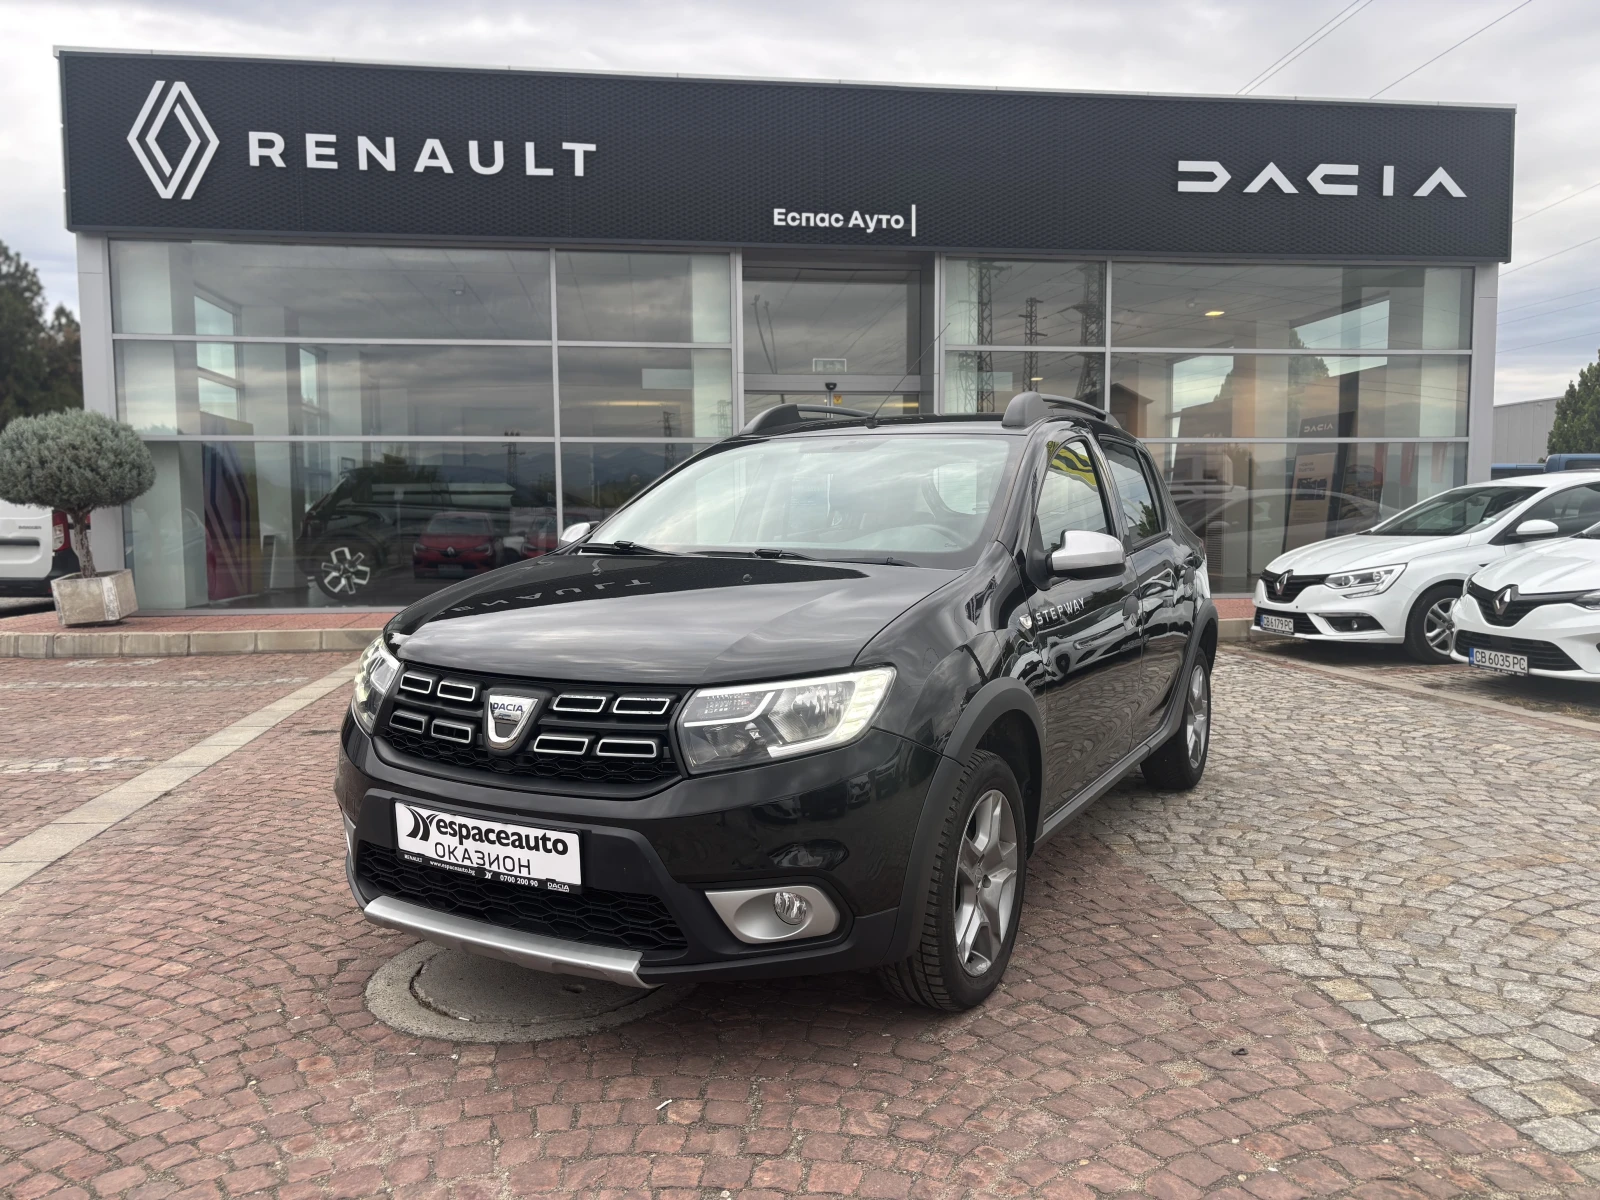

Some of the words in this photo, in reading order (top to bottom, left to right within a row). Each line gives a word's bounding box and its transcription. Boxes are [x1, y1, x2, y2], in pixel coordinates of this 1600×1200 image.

[248, 130, 597, 178] RENAULT
[1177, 160, 1468, 198] DACIA
[773, 208, 844, 228] Еспас
[848, 210, 905, 233] Ауто
[1303, 423, 1334, 433] DACIA
[1035, 597, 1085, 625] STEPWAY
[1488, 653, 1511, 668] 6035
[493, 702, 523, 712] DACIA
[435, 818, 569, 856] espaceauto
[434, 842, 532, 876] ОКАЗИОН
[429, 860, 476, 875] www.espaceauto.bg
[500, 874, 516, 884] 0700
[516, 878, 529, 886] 200
[530, 880, 539, 888] 90
[547, 881, 570, 891] DACIA
